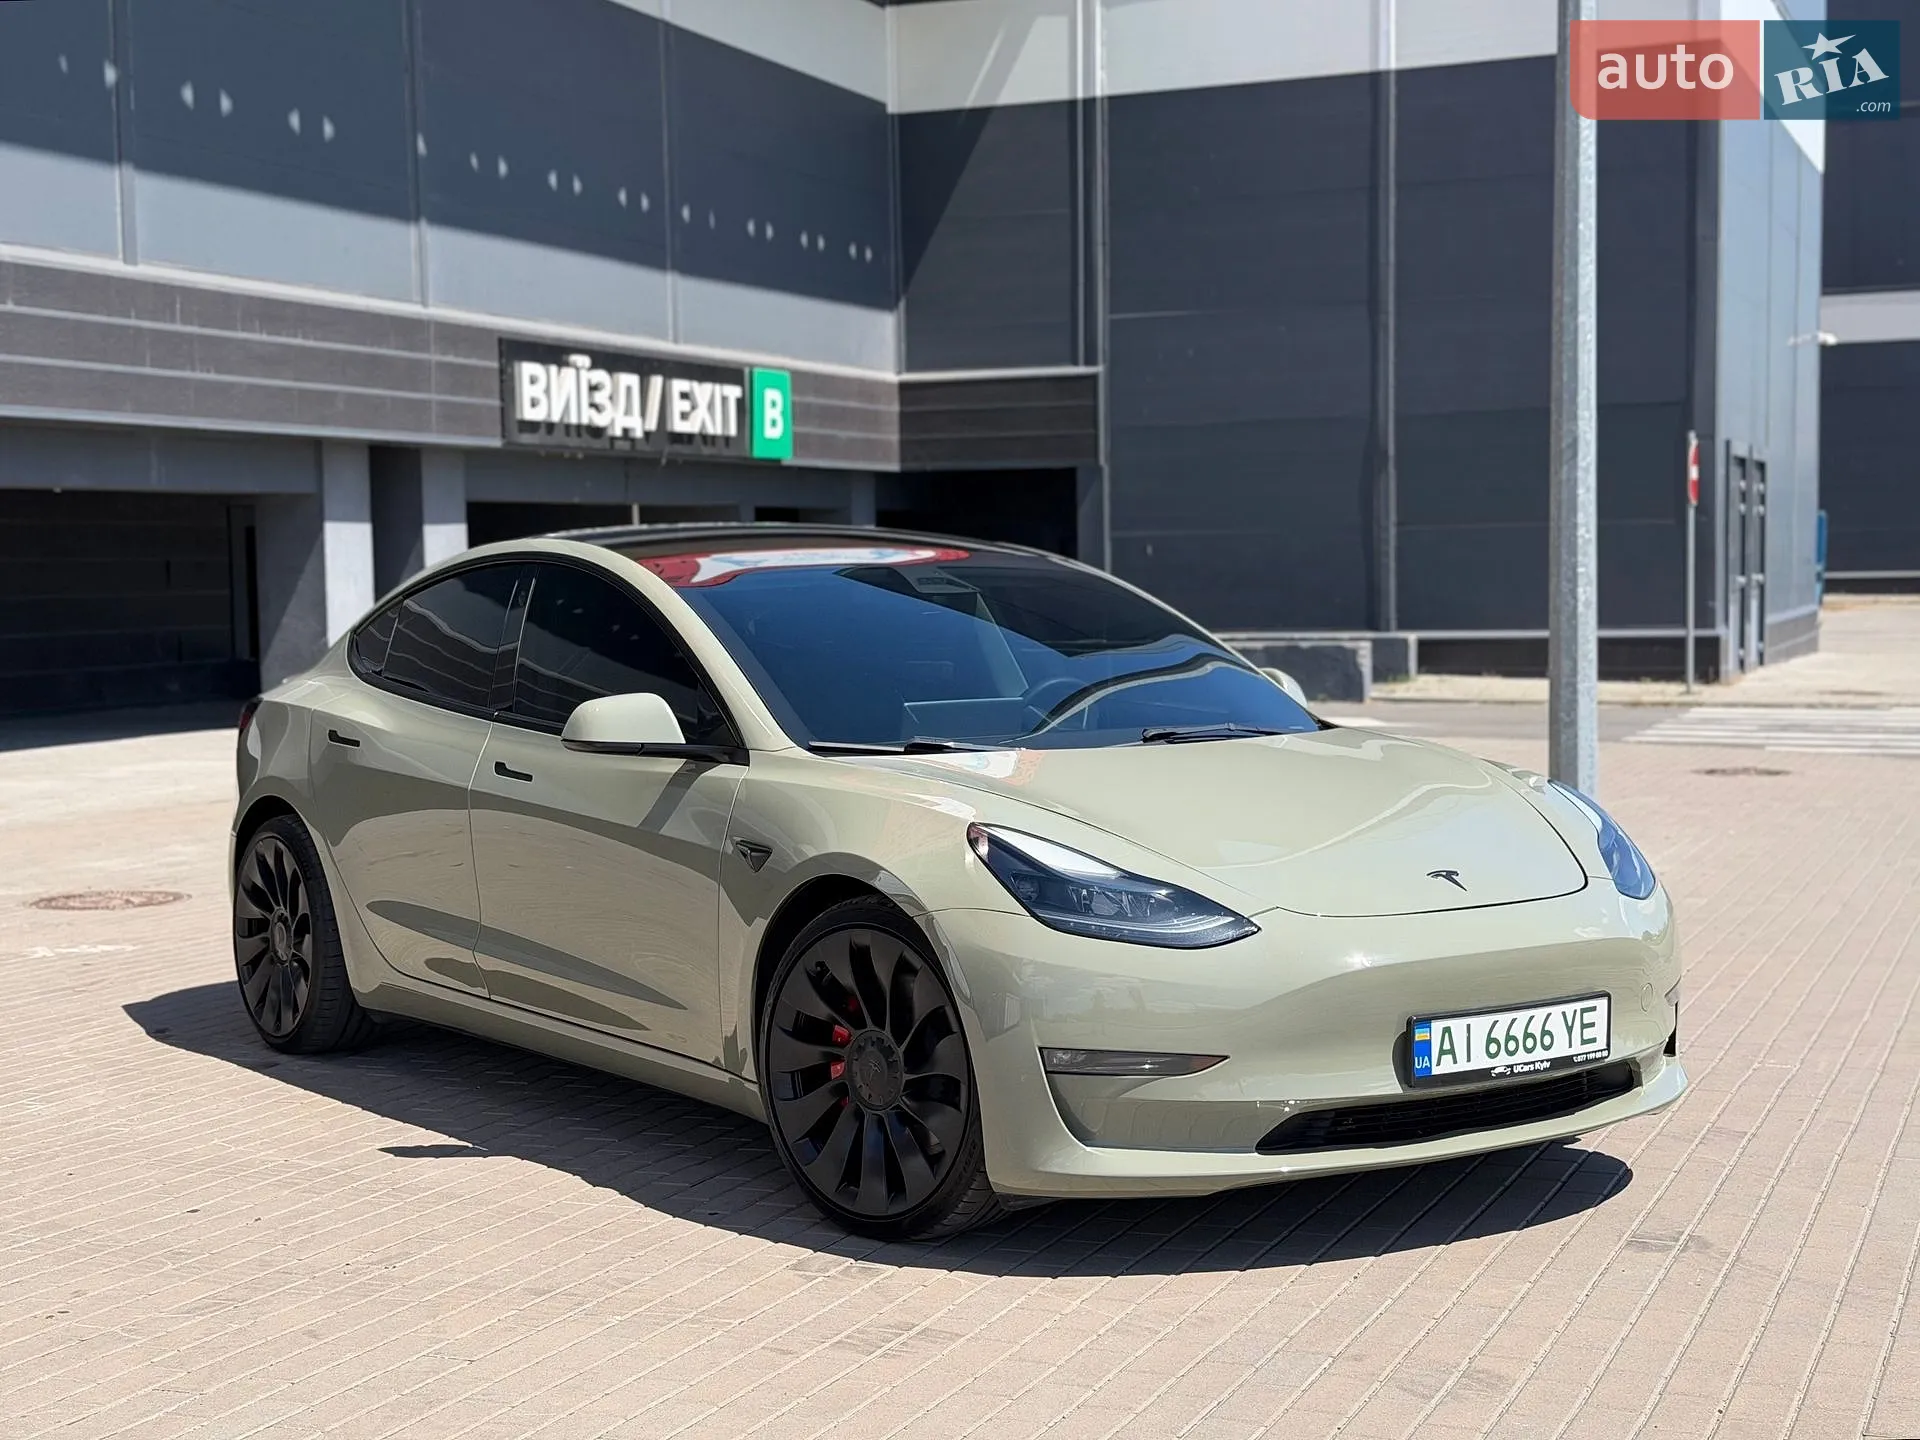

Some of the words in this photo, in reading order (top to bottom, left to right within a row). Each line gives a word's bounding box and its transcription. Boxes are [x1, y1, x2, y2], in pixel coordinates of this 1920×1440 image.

[515, 354, 643, 438] ВИЇЗД
[667, 378, 742, 437] EXIT
[1436, 1023, 1472, 1067] AI
[1485, 1012, 1555, 1060] 6666
[1561, 1005, 1598, 1049] YE
[1415, 1055, 1430, 1069] UA
[1513, 1064, 1534, 1073] UCars
[1535, 1060, 1551, 1071] Kyiv
